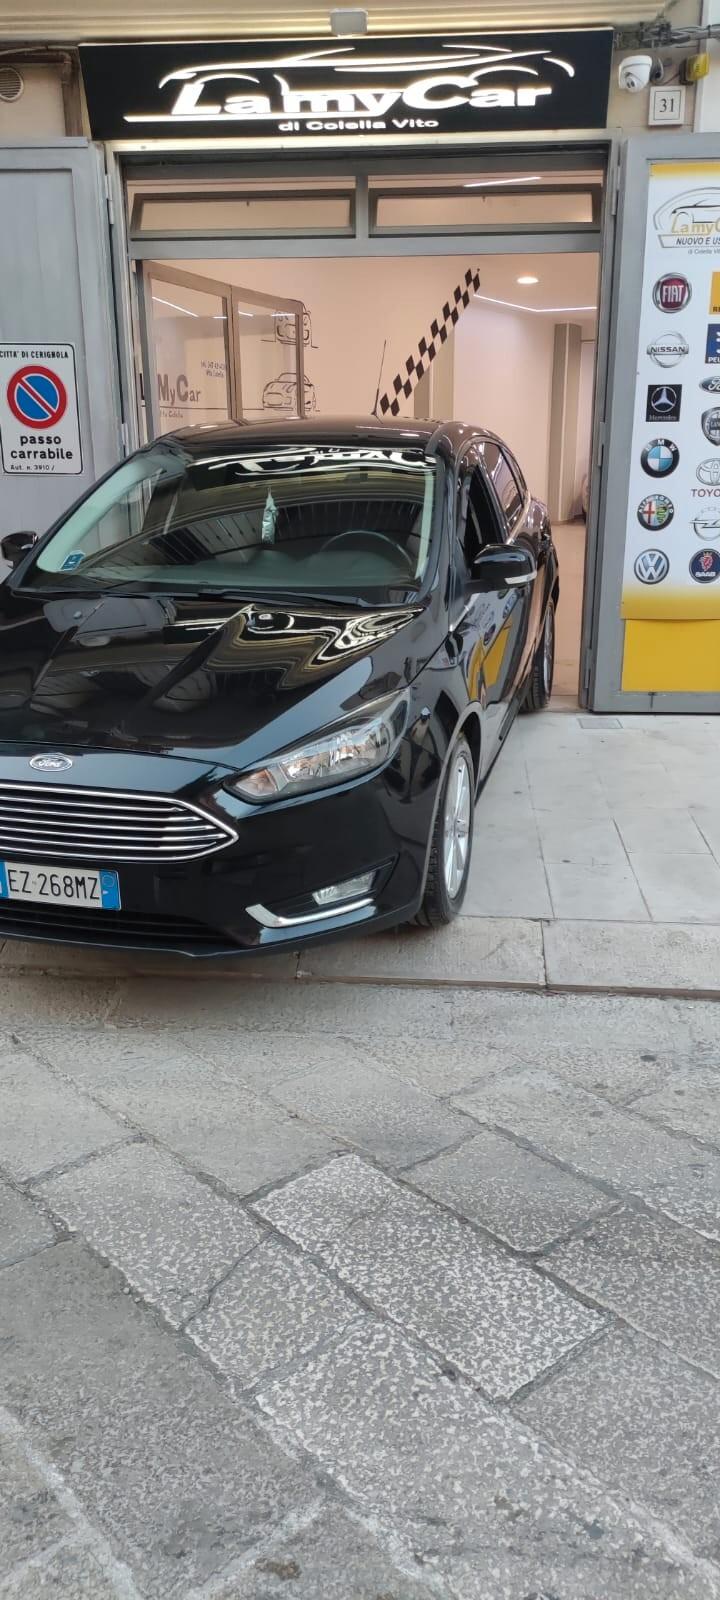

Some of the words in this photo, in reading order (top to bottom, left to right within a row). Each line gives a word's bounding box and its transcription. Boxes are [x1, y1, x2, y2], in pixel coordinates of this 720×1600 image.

[659, 98, 675, 113] 31
[278, 120, 300, 131] di
[306, 119, 386, 131] Colella
[392, 118, 439, 129] Vito
[675, 237, 704, 245] NUOVO
[705, 237, 711, 245] E
[662, 285, 684, 302] FIAT
[30, 351, 69, 359] CERIGNOLA
[20, 435, 62, 446] passo
[10, 449, 73, 460] carrabile
[7, 869, 32, 894] EZ
[37, 873, 100, 900] 268MZ
